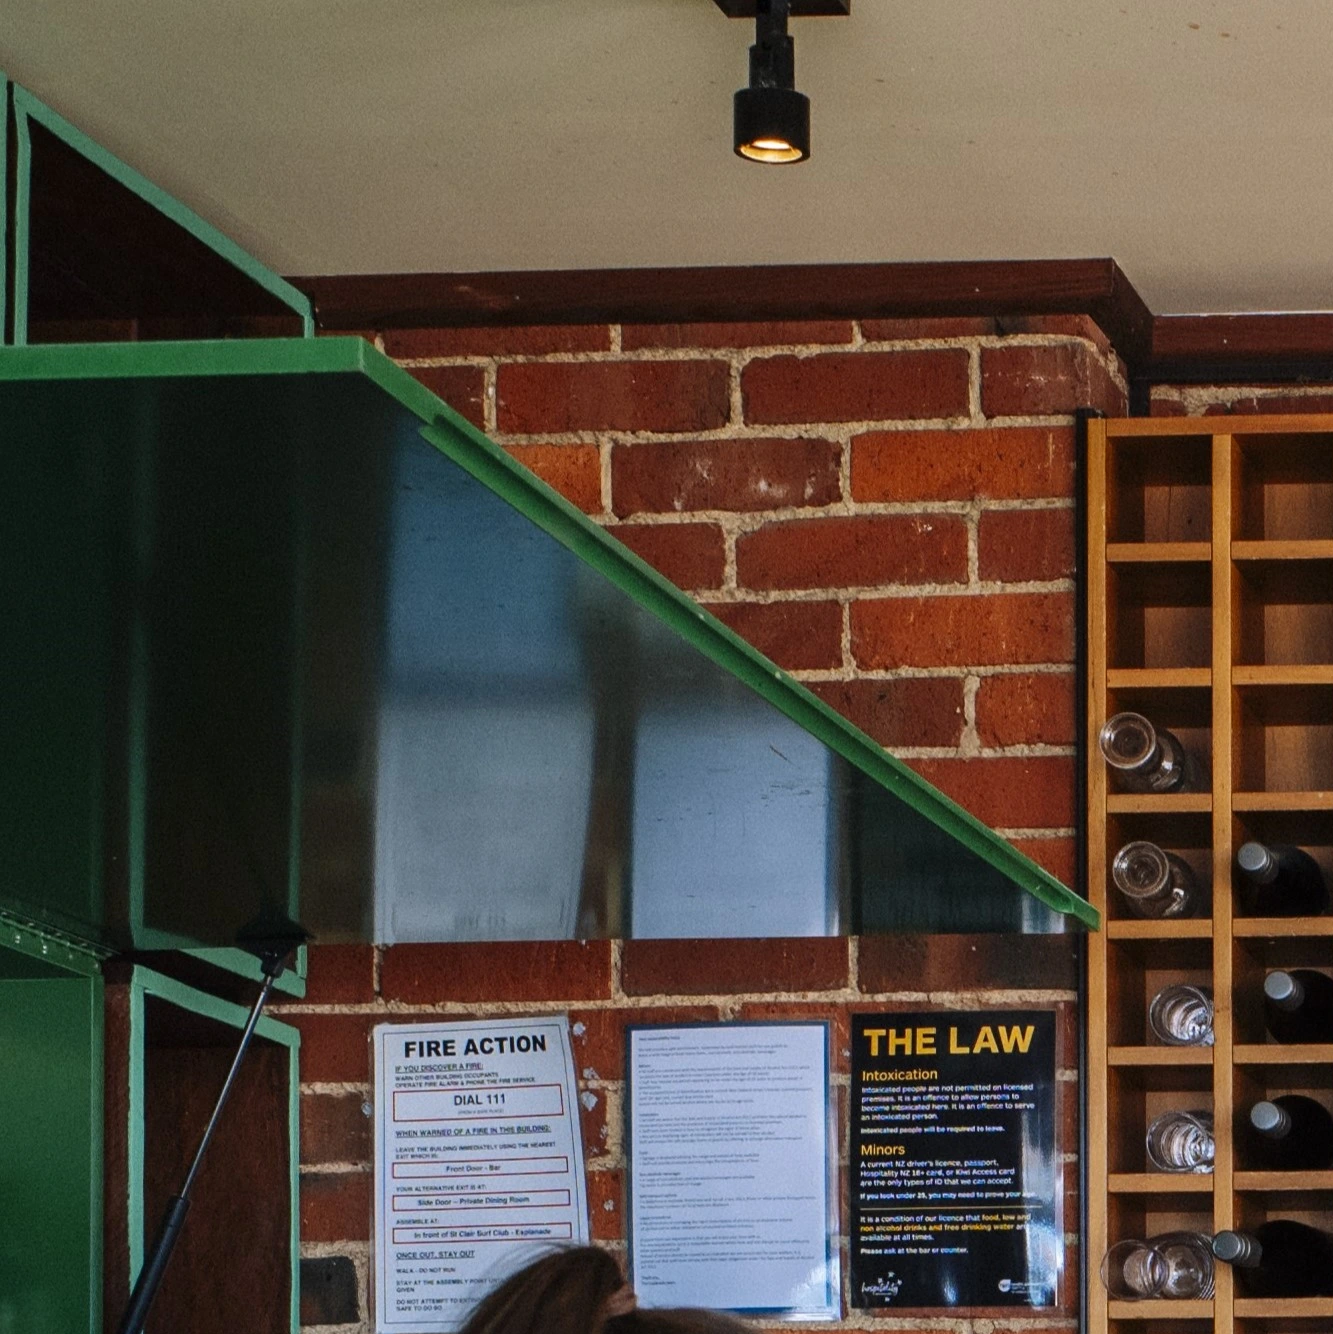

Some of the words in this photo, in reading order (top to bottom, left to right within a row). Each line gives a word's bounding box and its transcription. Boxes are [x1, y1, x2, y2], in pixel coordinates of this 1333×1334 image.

[863, 1027, 937, 1056] THE
[949, 1025, 1035, 1054] LAW
[404, 1040, 456, 1058] FIRE
[464, 1035, 546, 1056] ACTION
[420, 1063, 457, 1071] DISCOVER
[862, 1068, 938, 1081] Intoxication
[902, 1085, 926, 1093] people
[955, 1084, 990, 1092] permitted
[454, 1094, 482, 1105] DIAL
[487, 1093, 505, 1103] 111
[420, 1128, 451, 1136] WARNED
[899, 1126, 922, 1134] people
[946, 1125, 975, 1133] required
[860, 1144, 906, 1156] Minors
[861, 1169, 897, 1177] Hospitality
[887, 1178, 902, 1186] only
[903, 1178, 924, 1186] types
[485, 1197, 507, 1205] Dining
[961, 1223, 991, 1231] drinking
[515, 1228, 551, 1236] Esplanade
